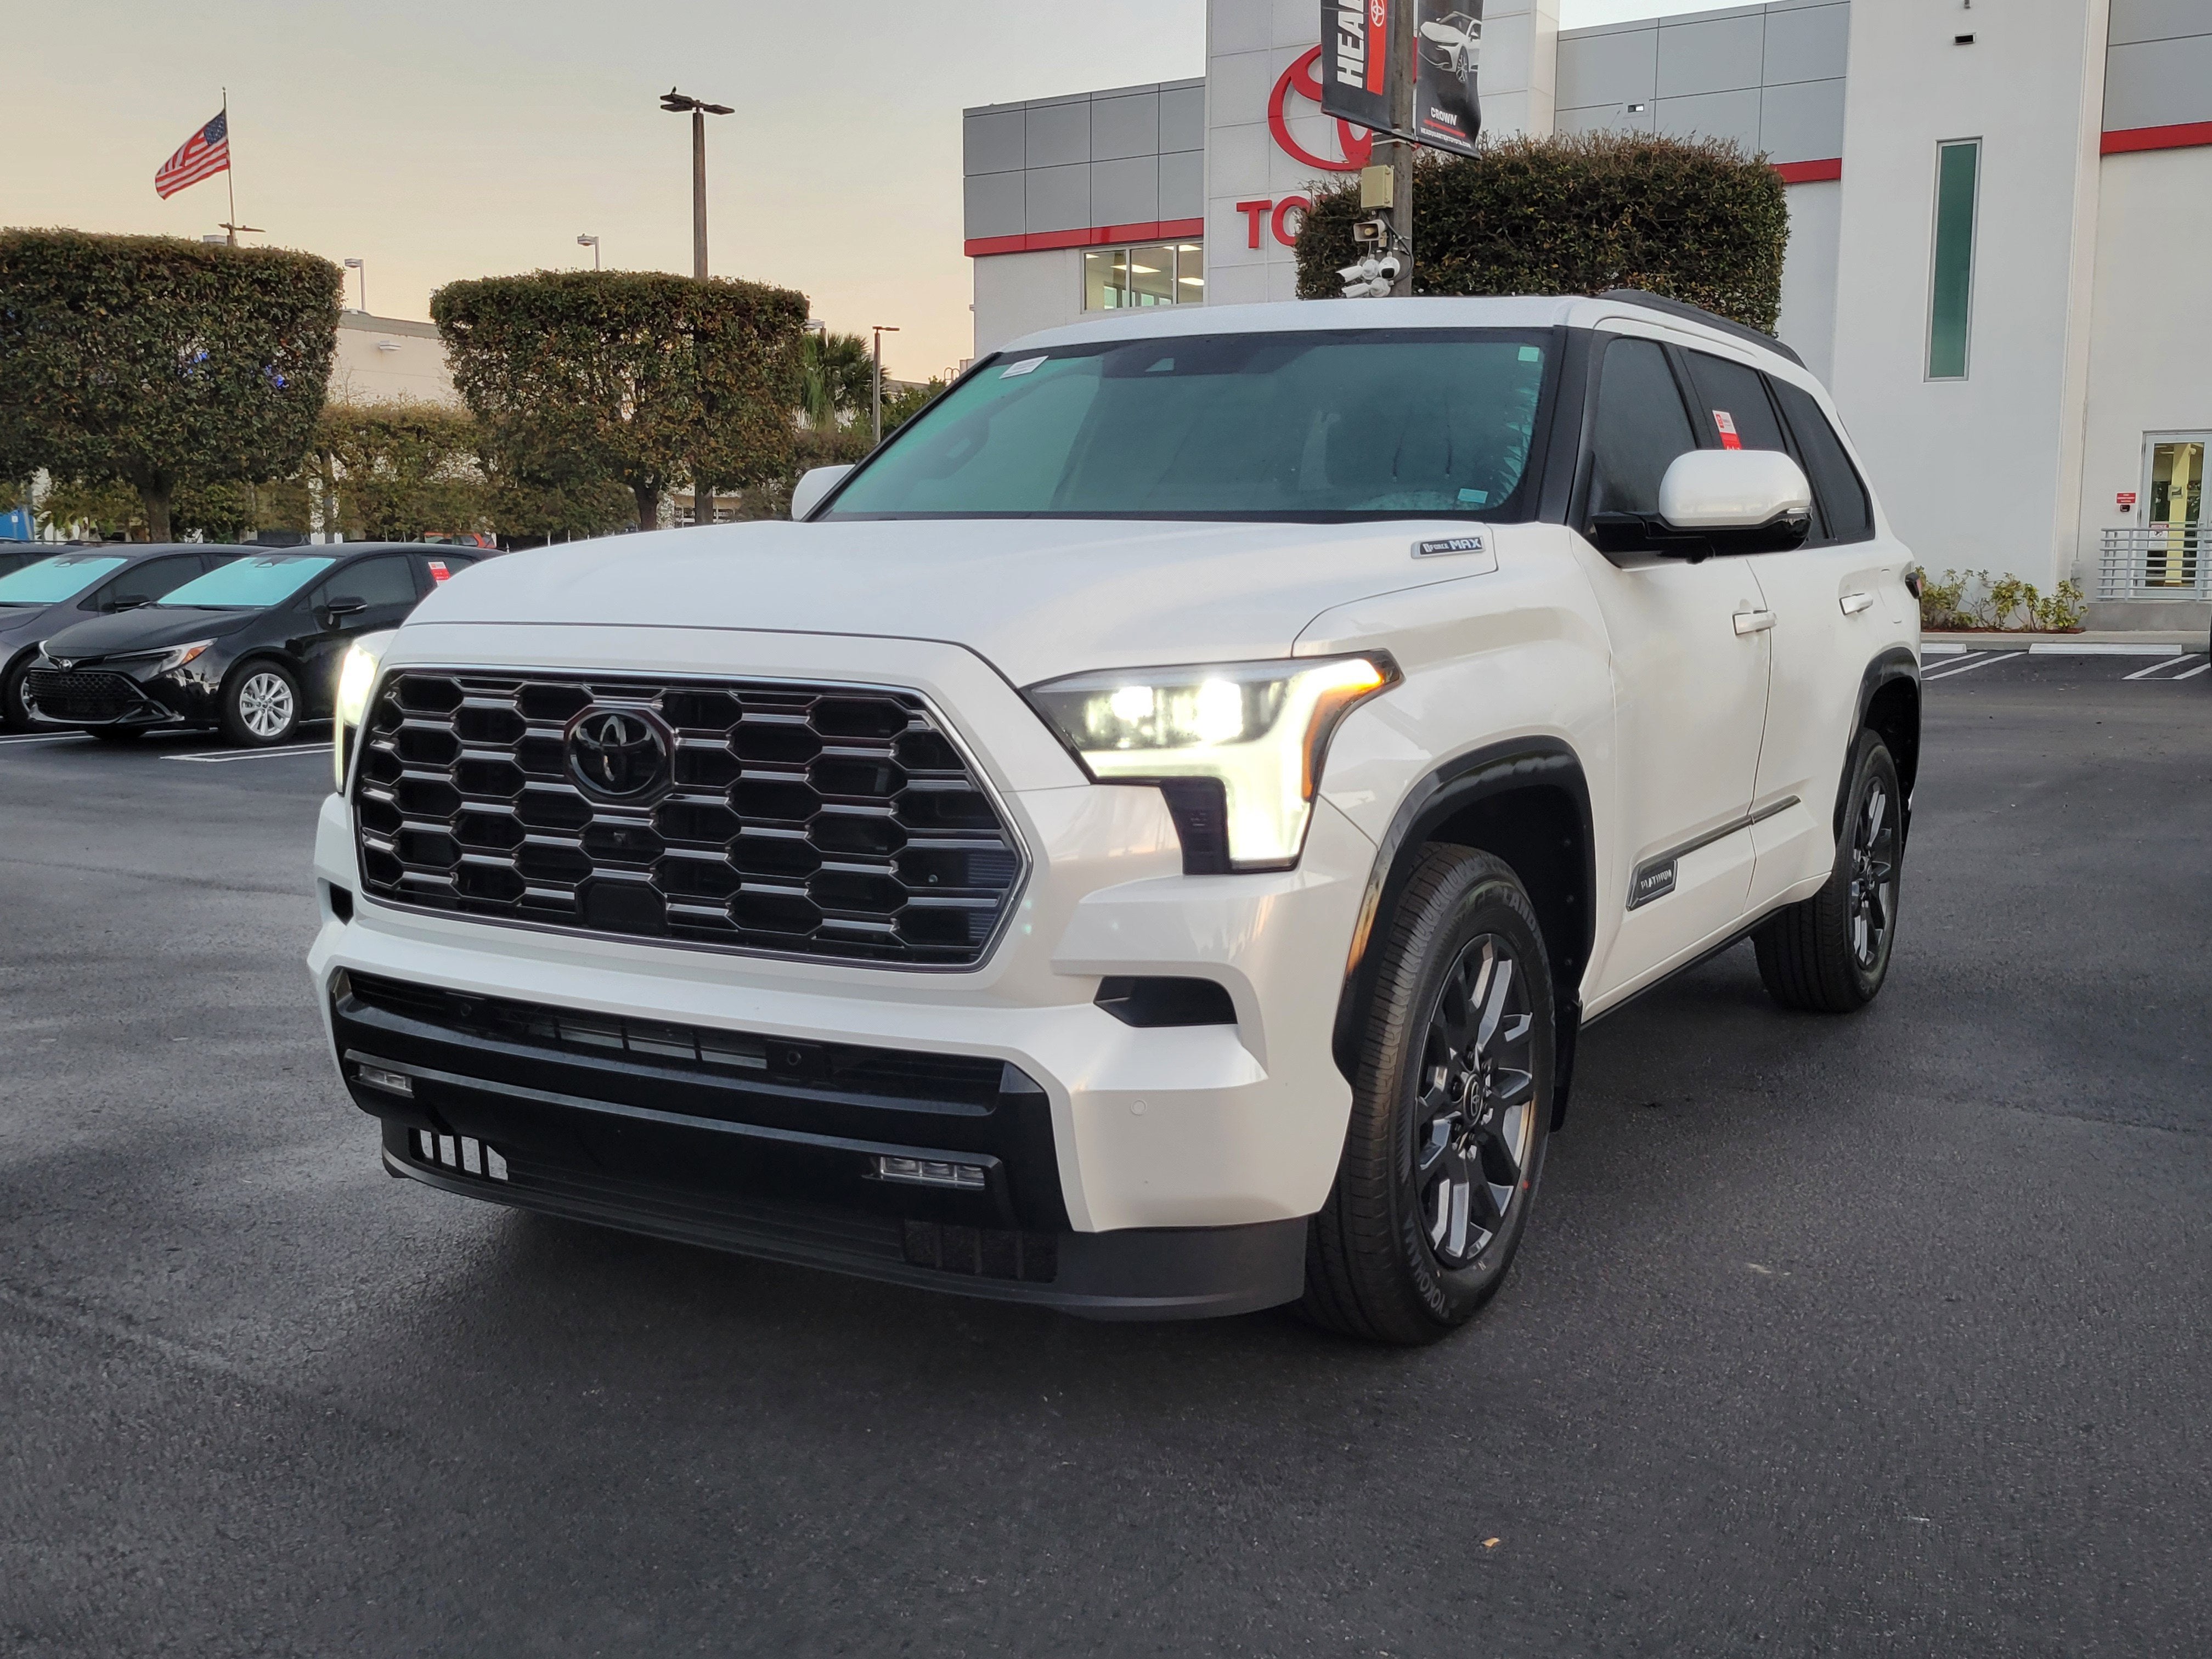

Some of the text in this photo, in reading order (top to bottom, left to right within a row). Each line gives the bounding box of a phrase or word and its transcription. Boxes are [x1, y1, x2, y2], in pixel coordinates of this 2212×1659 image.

[1431, 106, 1457, 126] CROWN
[1236, 194, 1314, 249] TO
[1449, 539, 1482, 550] MAX
[1640, 869, 1672, 890] PLATINUM
[1403, 1211, 1446, 1316] YOKOHAMA
